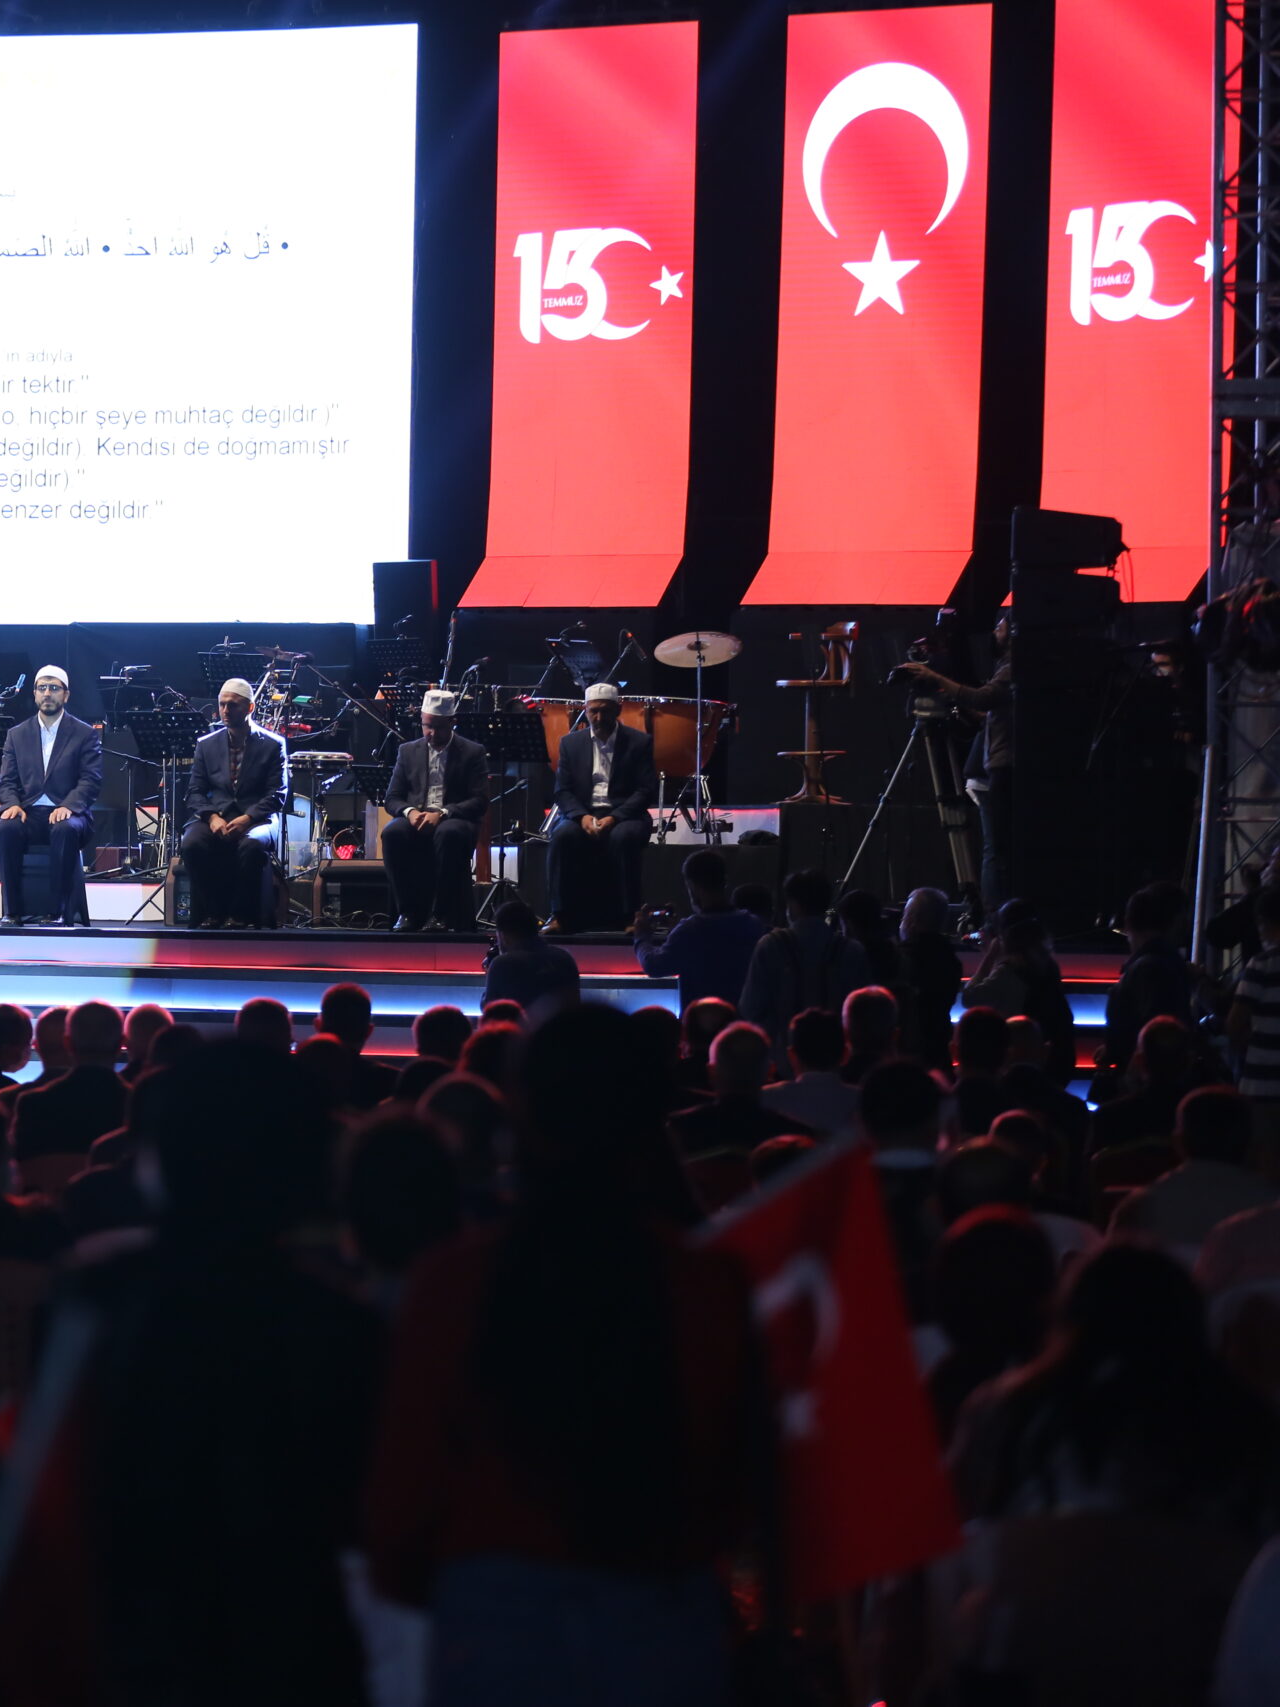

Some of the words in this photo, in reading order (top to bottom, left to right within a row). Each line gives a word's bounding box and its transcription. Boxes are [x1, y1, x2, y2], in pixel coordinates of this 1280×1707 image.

[513, 228, 608, 344] 15
[1092, 273, 1131, 287] TEMMUZ
[543, 296, 583, 308] TEMMUZ
[29, 348, 73, 365] adıyla
[95, 409, 147, 430] şeye
[155, 405, 233, 430] muhtaç
[183, 437, 210, 456] de
